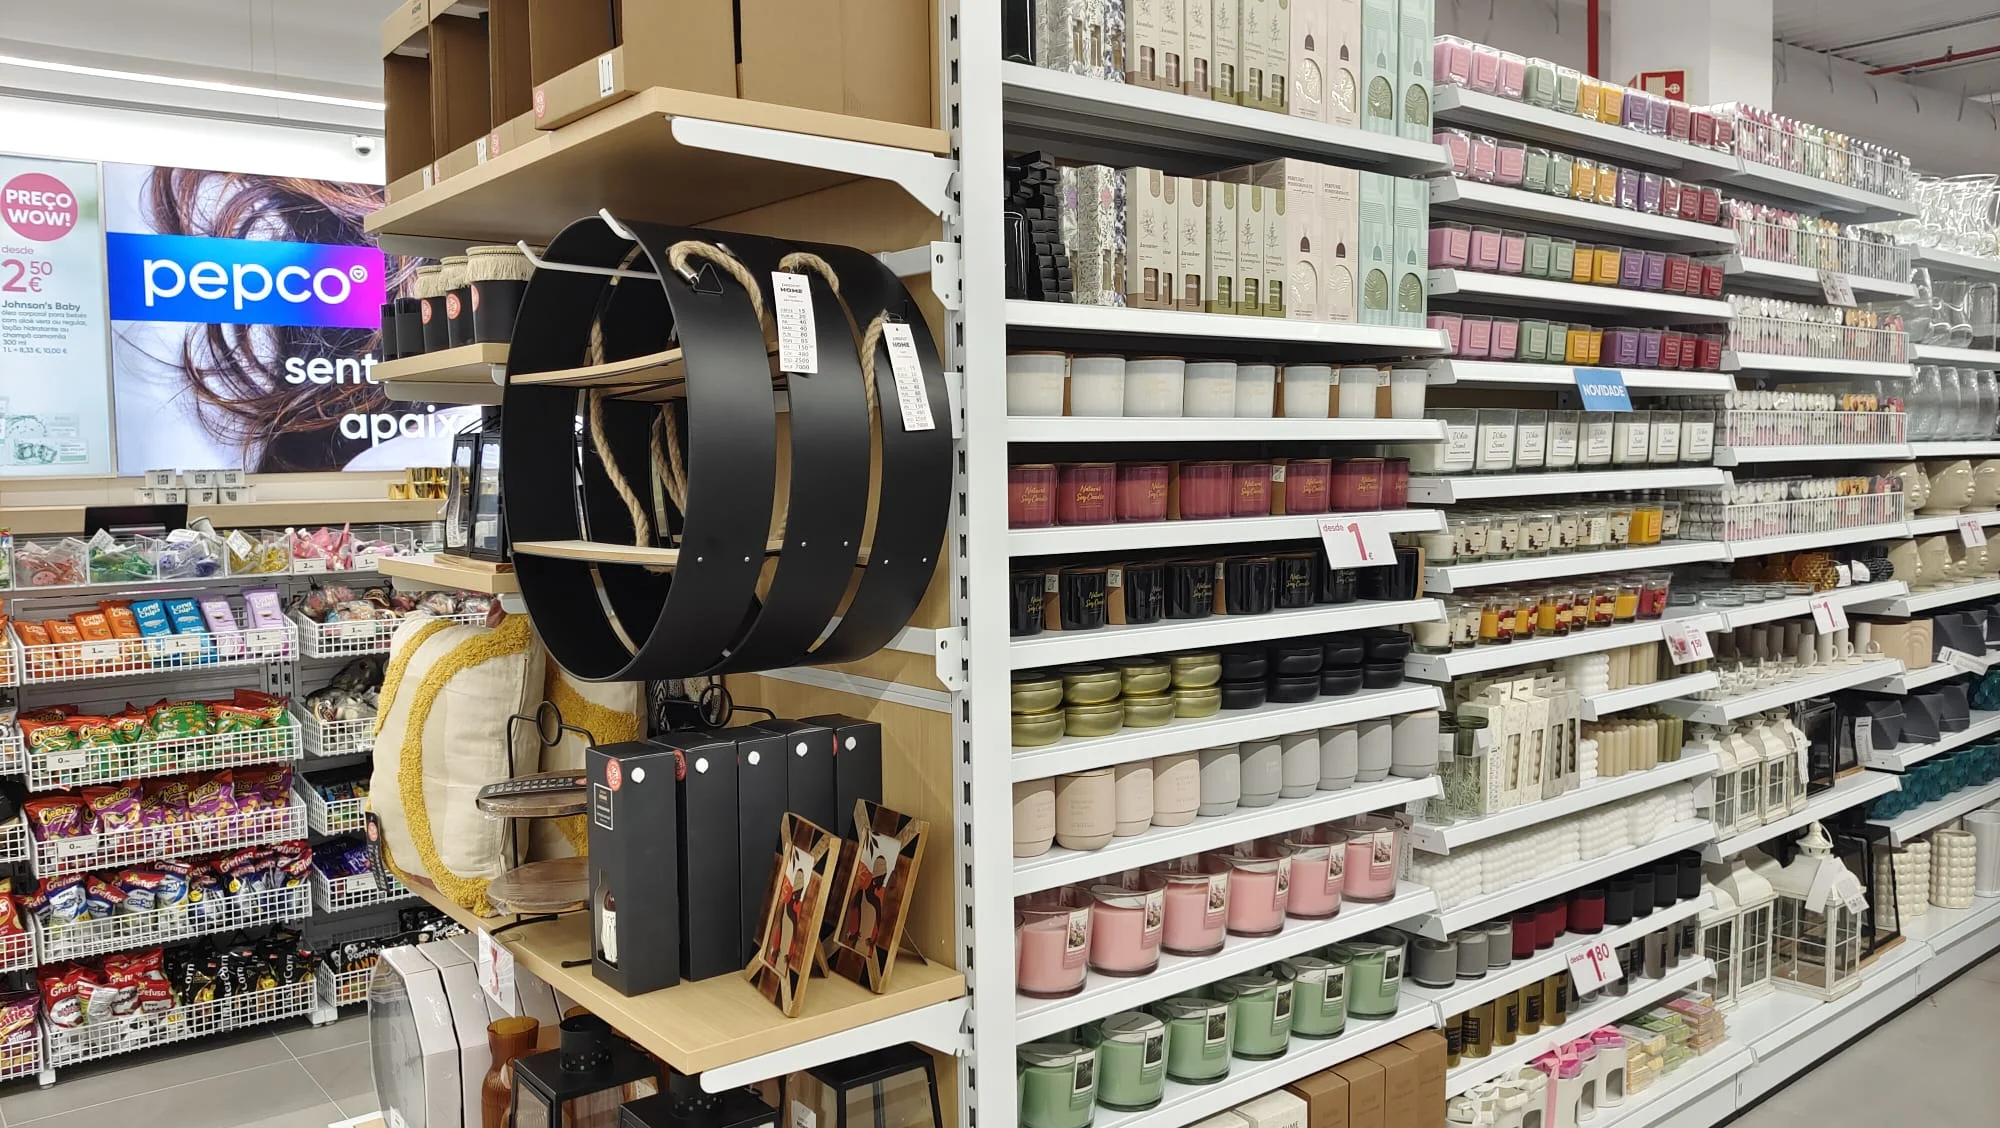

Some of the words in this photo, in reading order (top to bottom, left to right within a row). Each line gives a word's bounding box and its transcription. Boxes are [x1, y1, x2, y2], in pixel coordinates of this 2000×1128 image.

[6, 189, 72, 210] PREÇO
[7, 208, 71, 227] WOW!
[1, 245, 34, 255] desde
[1, 258, 27, 293] 2
[30, 261, 53, 276] 50
[28, 277, 42, 293] €
[143, 257, 351, 310] pepco
[2, 300, 53, 310] Johnson's
[55, 302, 81, 312] Baby
[285, 353, 380, 385] sent
[1583, 384, 1625, 397] NOVIDADE
[339, 404, 458, 448] apaix
[1080, 483, 1101, 494] Natural
[1322, 523, 1344, 532] desde
[1347, 522, 1368, 561] 1
[137, 602, 159, 614] Long
[139, 607, 161, 618] Chips
[171, 601, 193, 612] Long
[173, 605, 195, 616] Chips
[81, 614, 104, 622] Long
[94, 787, 131, 810] Cheetos
[187, 780, 220, 808] Cheetos
[38, 803, 77, 826] Cheetos
[154, 861, 189, 875] Grefusa
[219, 851, 254, 874] Grefusa
[46, 874, 81, 891] Grefusa
[89, 884, 122, 904] Grefusa
[1594, 943, 1610, 961] 80
[346, 956, 378, 972] CAND
[1586, 948, 1603, 982] 1
